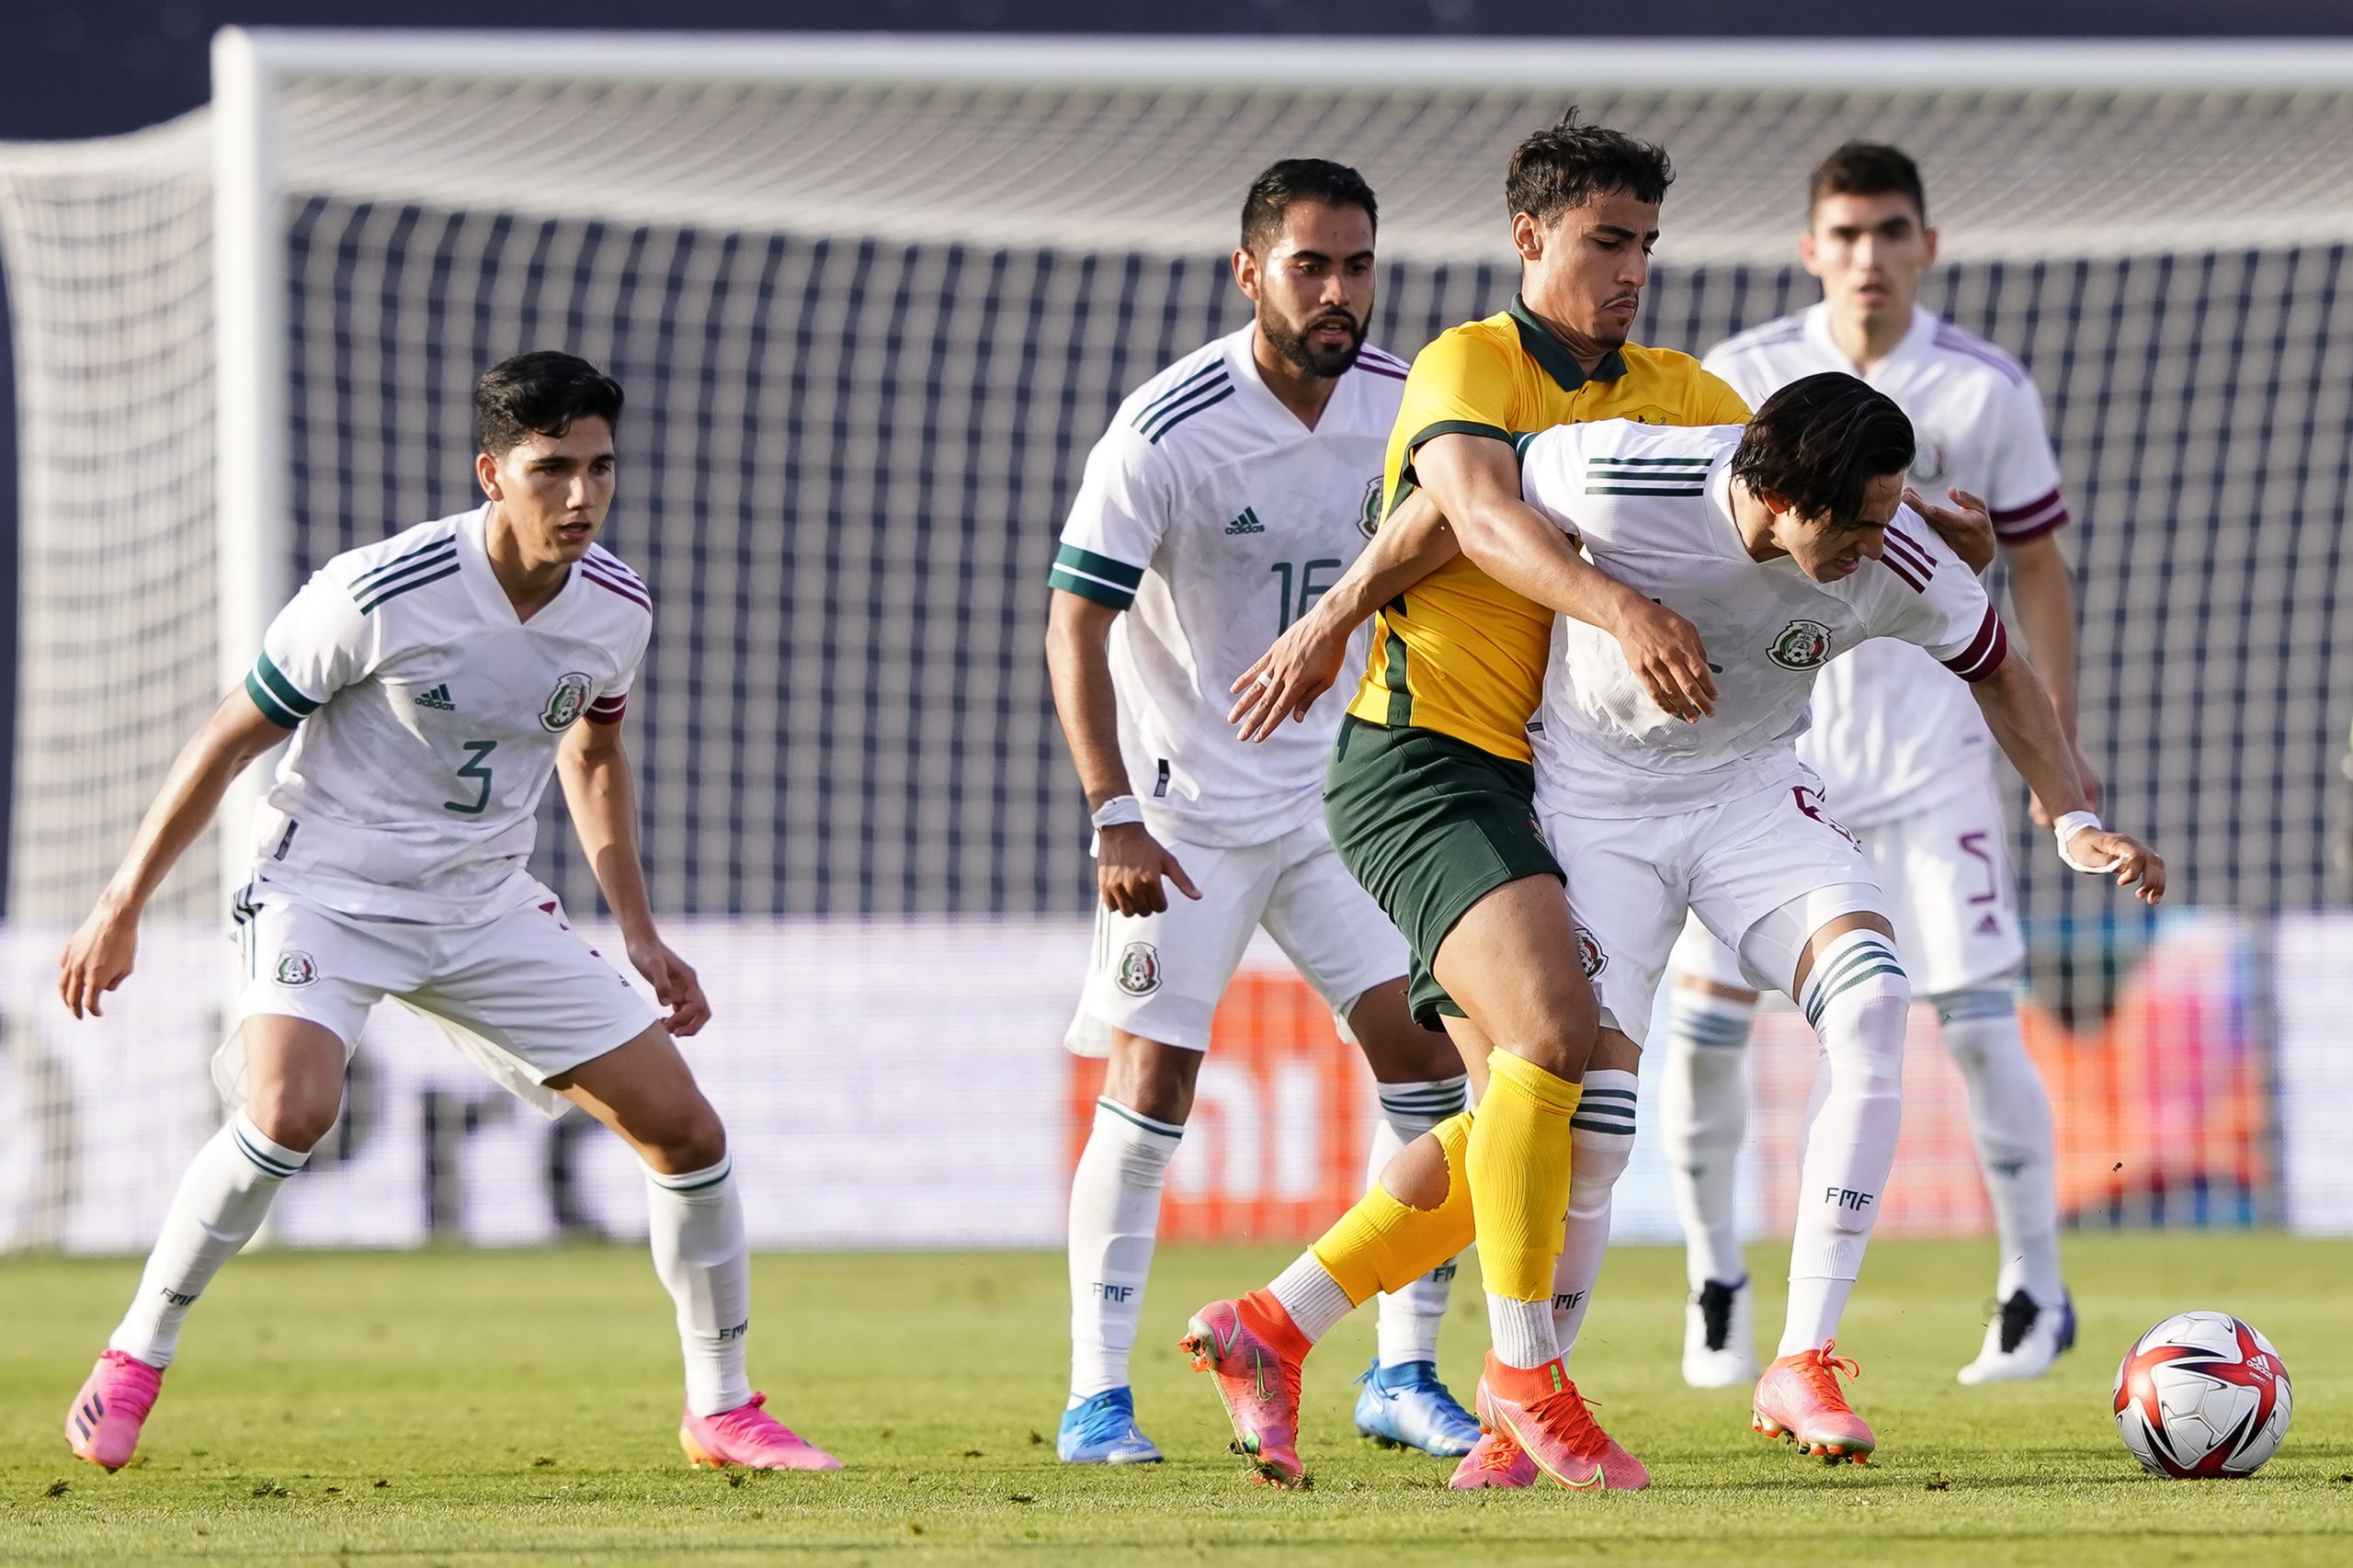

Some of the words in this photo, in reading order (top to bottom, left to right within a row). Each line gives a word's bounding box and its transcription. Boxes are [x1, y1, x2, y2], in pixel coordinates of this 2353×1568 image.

[1224, 524, 1266, 535] adidas
[415, 697, 456, 711] adidas
[444, 740, 497, 814] 3
[1824, 1187, 1874, 1212] FMF
[1092, 1281, 1134, 1303] FMF
[1551, 1290, 1586, 1310] MF
